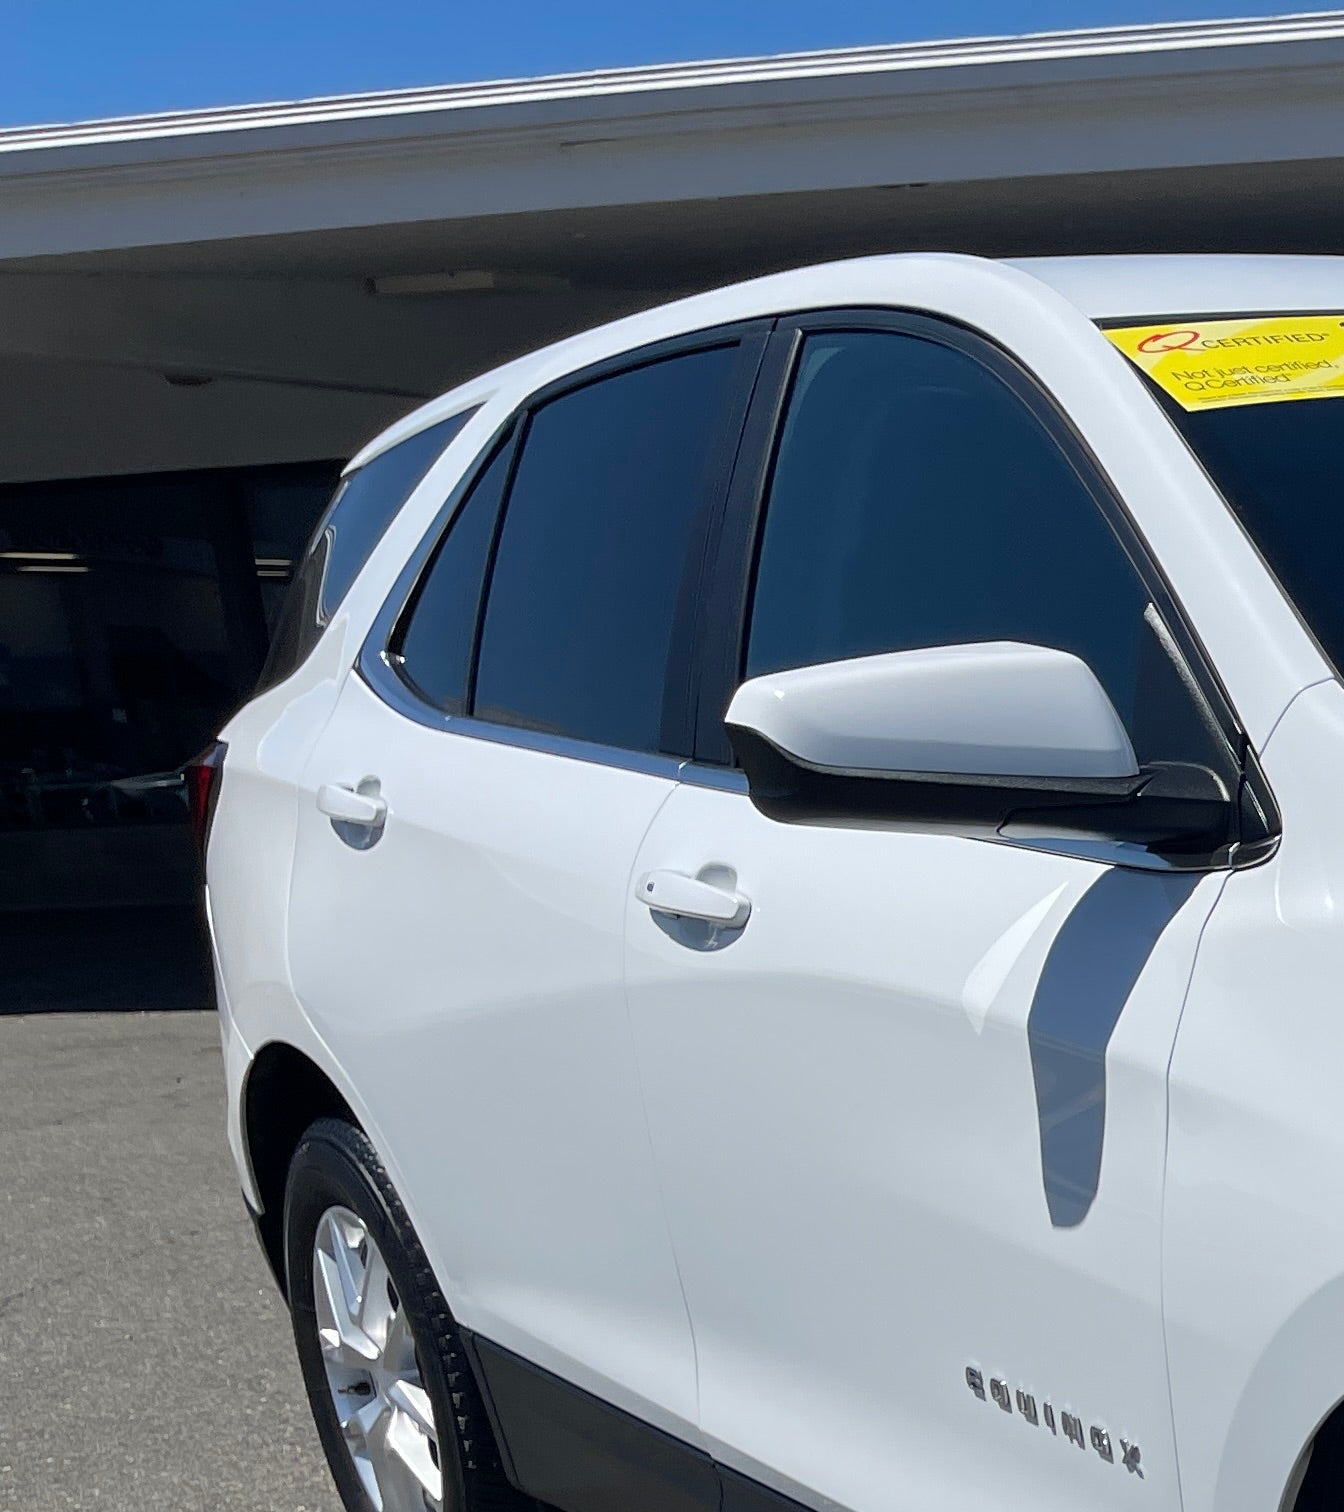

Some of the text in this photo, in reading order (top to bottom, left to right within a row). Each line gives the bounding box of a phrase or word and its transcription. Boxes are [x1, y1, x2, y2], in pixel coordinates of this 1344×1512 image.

[1172, 368, 1214, 381] Not
[1214, 366, 1251, 379] just
[965, 1366, 1145, 1480] EQUINOX
